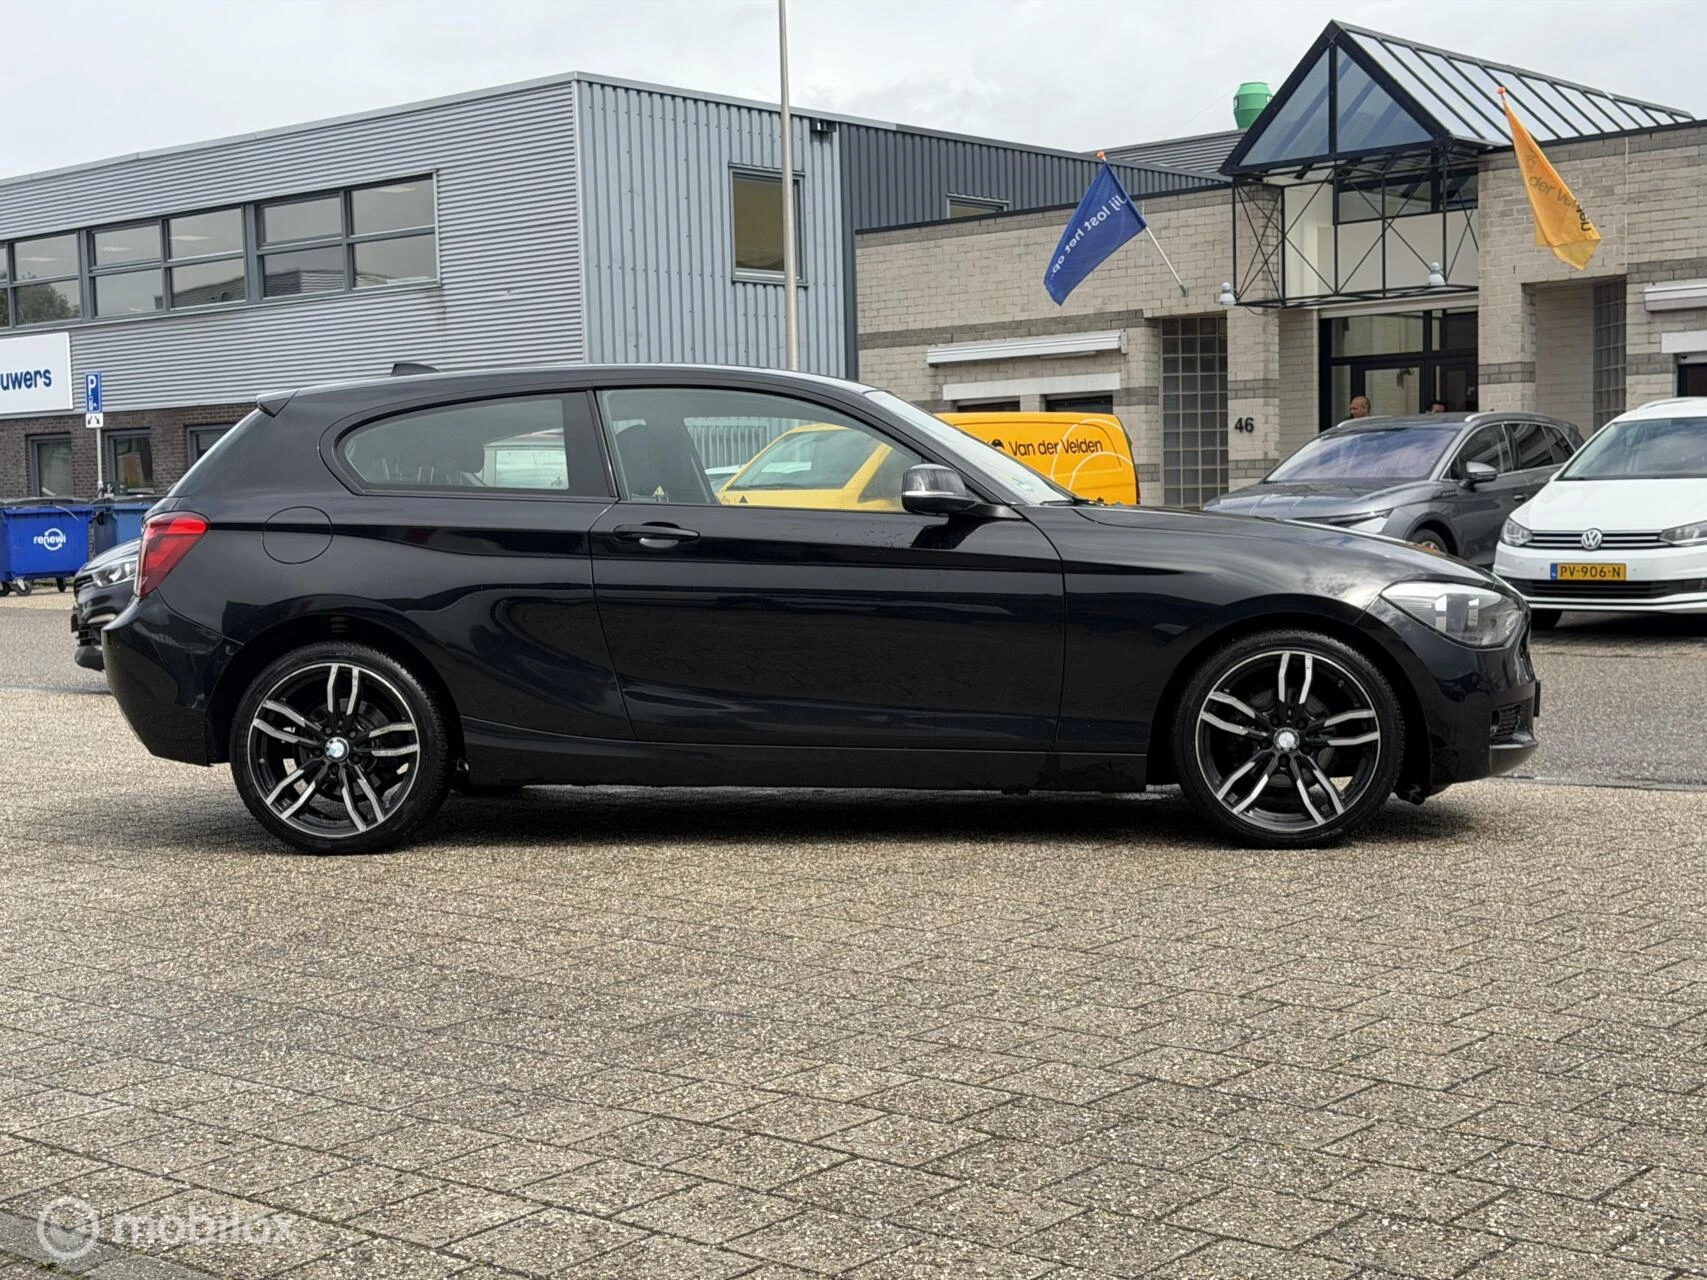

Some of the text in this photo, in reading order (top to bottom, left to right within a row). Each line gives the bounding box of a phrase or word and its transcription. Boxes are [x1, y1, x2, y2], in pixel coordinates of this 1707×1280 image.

[0, 369, 52, 391] uwers
[87, 375, 97, 396] P
[1234, 417, 1254, 433] 46
[1008, 437, 1104, 456] Van der Velden
[33, 533, 66, 545] renewi
[1560, 565, 1621, 578] PV-906-N
